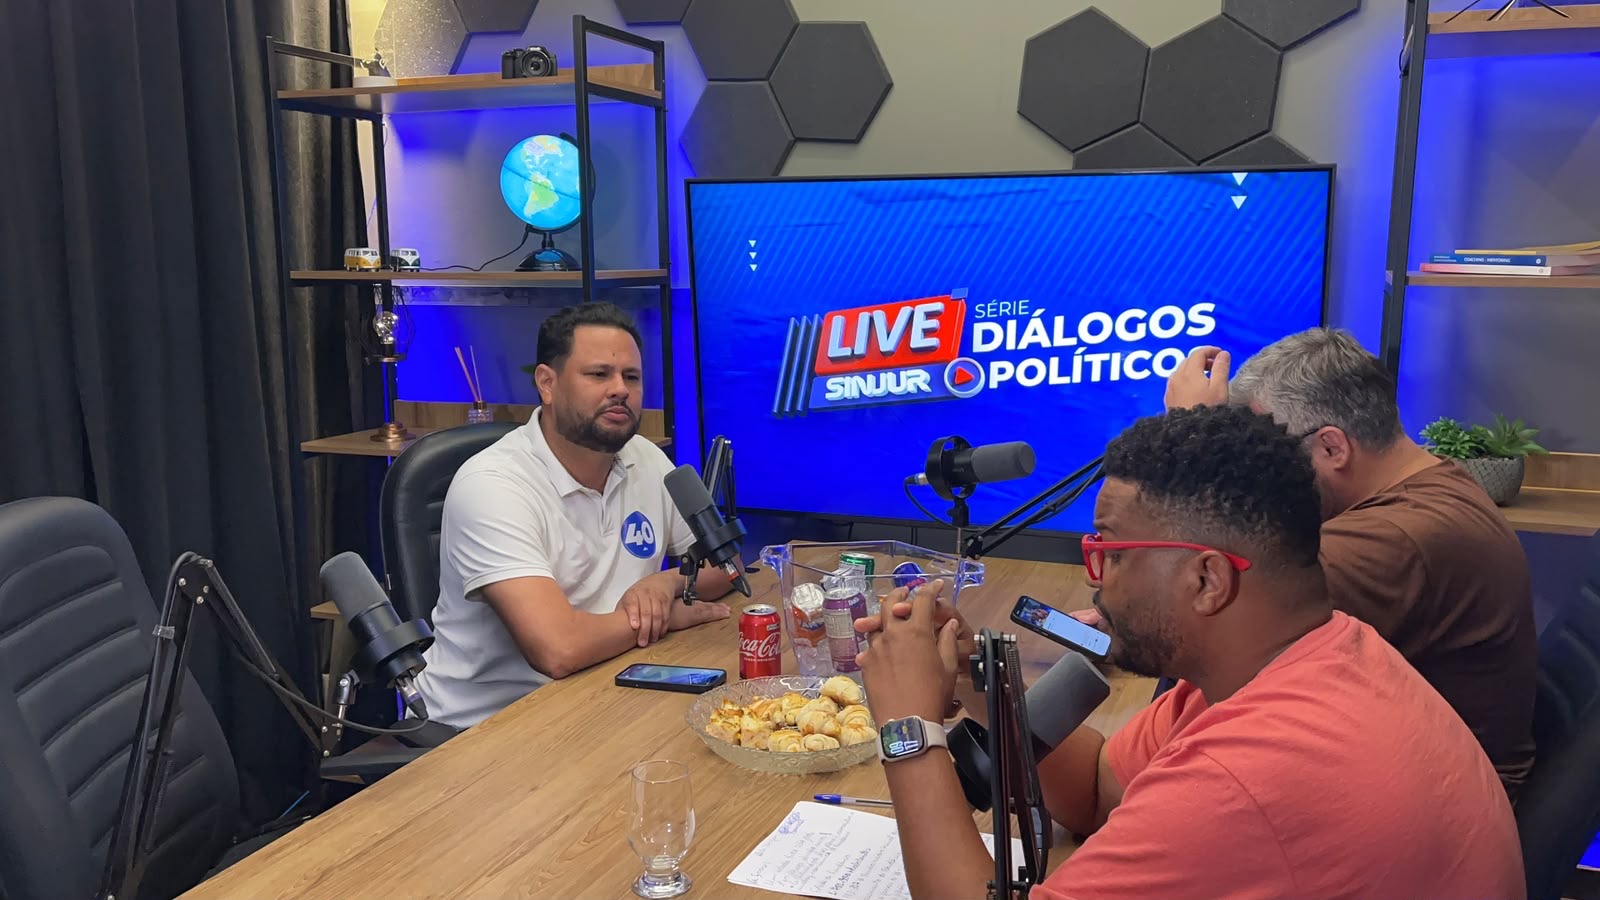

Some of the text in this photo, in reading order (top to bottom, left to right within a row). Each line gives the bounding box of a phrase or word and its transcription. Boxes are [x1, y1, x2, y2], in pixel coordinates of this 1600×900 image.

[972, 302, 1217, 353] DIÁLOGOS
[975, 299, 1030, 320] SÉRIE
[827, 300, 945, 361] LIVE
[824, 368, 932, 401] SINJUR
[988, 345, 1206, 389] POLÍTICO
[625, 521, 654, 546] 40
